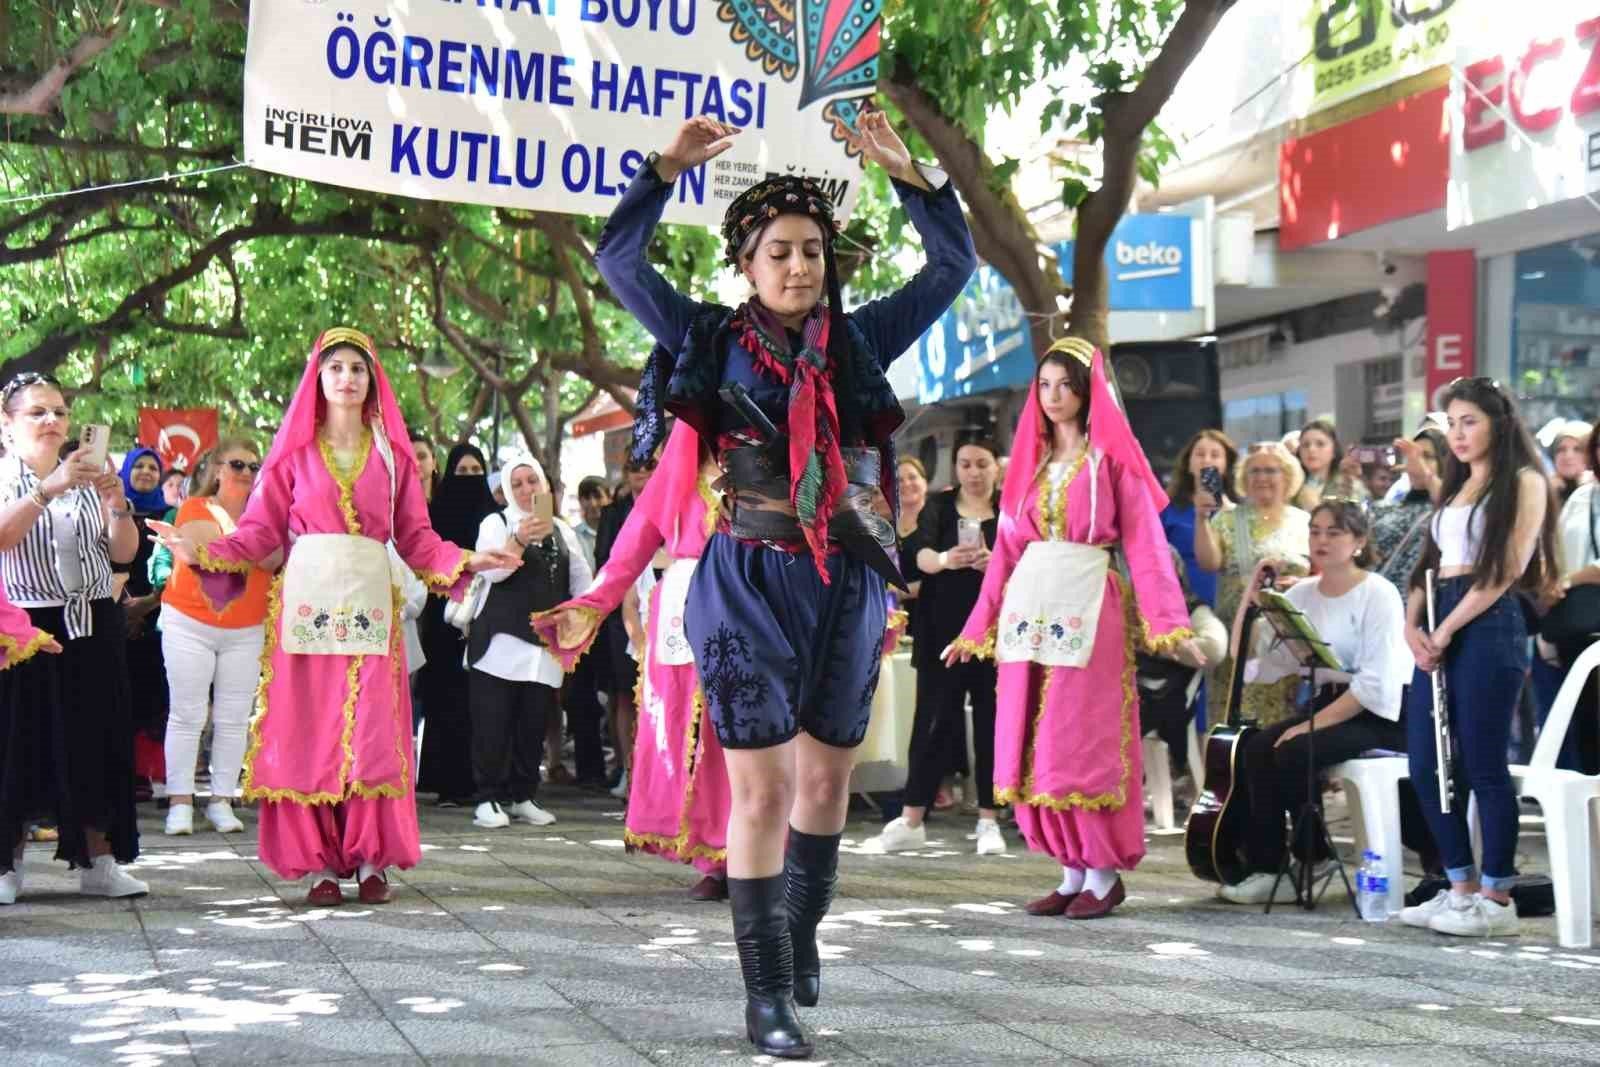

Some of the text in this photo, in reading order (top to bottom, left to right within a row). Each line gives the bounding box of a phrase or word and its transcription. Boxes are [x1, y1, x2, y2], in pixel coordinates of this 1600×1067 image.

[325, 11, 767, 129] ÖĞRENME HAFTASI
[265, 104, 374, 133] İNCİRLİOVA
[264, 119, 372, 161] HEM
[390, 123, 546, 189] KUTLU
[561, 143, 706, 205] OLSN
[1116, 240, 1182, 265] beko
